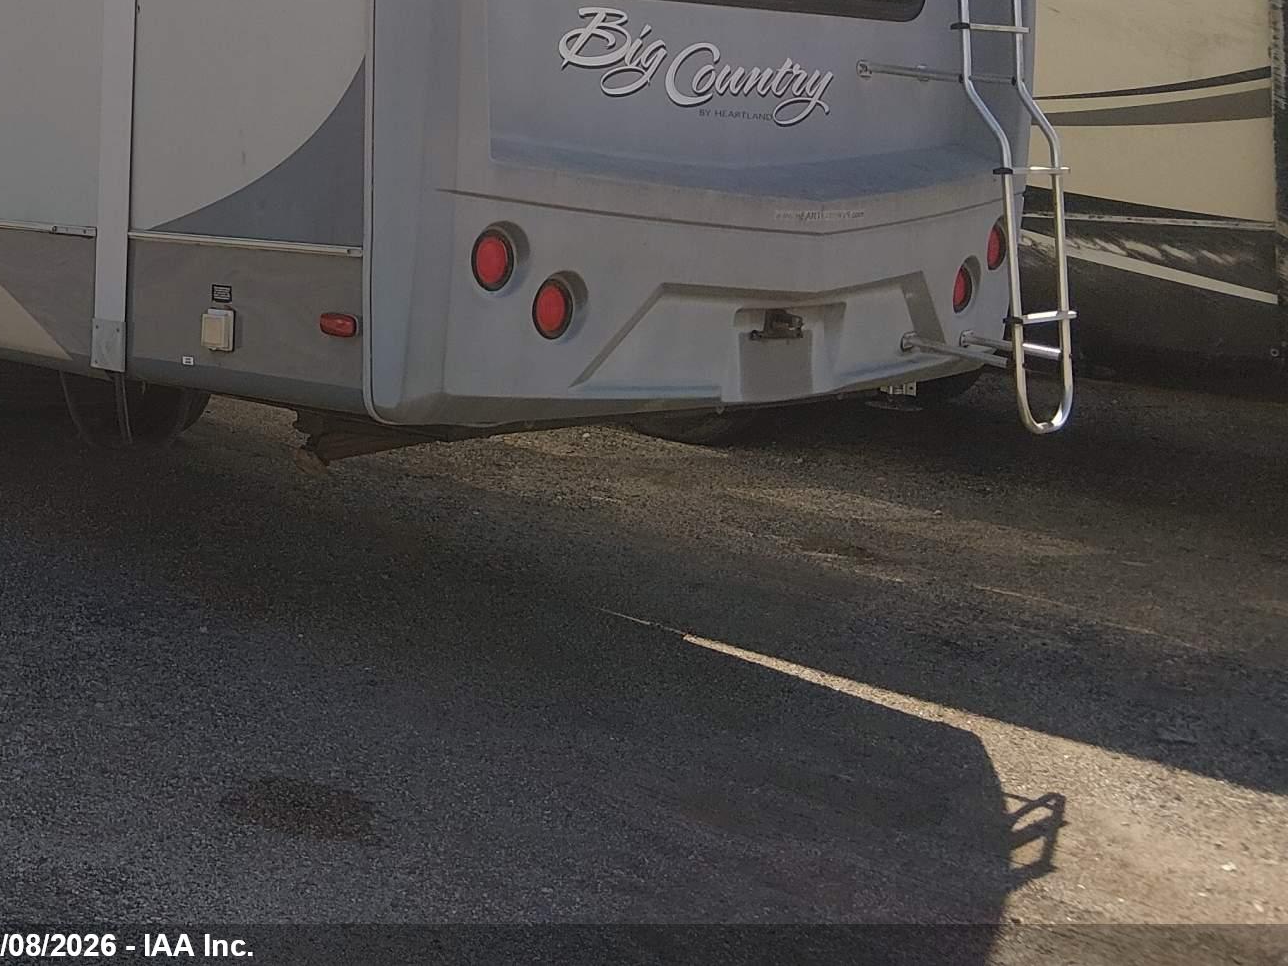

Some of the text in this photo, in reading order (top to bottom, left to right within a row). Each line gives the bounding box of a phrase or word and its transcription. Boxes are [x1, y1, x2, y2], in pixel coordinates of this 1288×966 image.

[558, 6, 835, 127] Big Country
[699, 108, 774, 121] BY HEARTLAND
